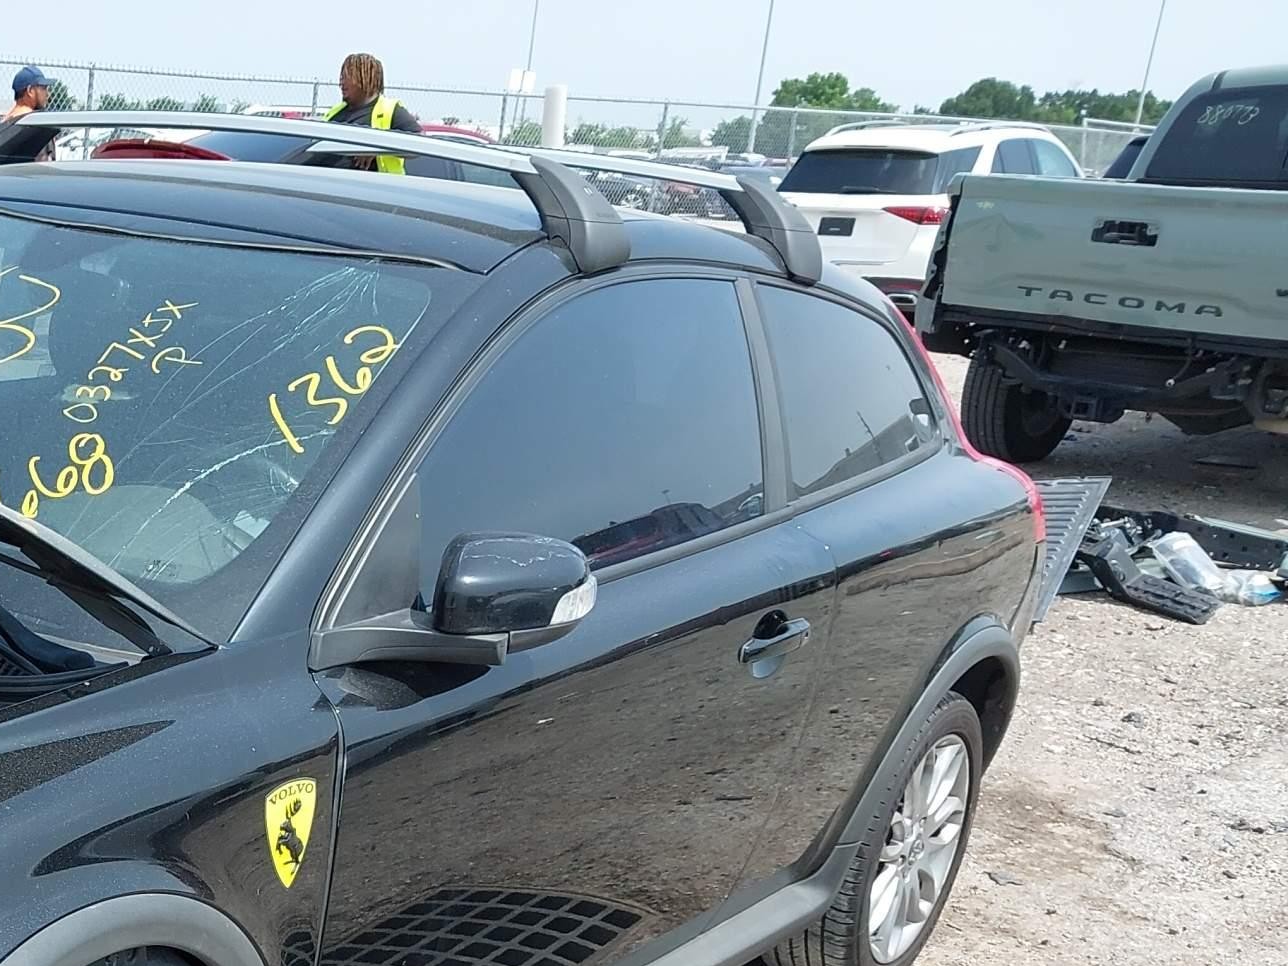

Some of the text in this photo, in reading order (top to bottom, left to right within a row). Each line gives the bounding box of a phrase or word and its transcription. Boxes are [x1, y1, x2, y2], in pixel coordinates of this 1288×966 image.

[1017, 286, 1223, 317] TACOMA
[268, 324, 400, 454] 1362
[269, 782, 314, 805] VOLVO
